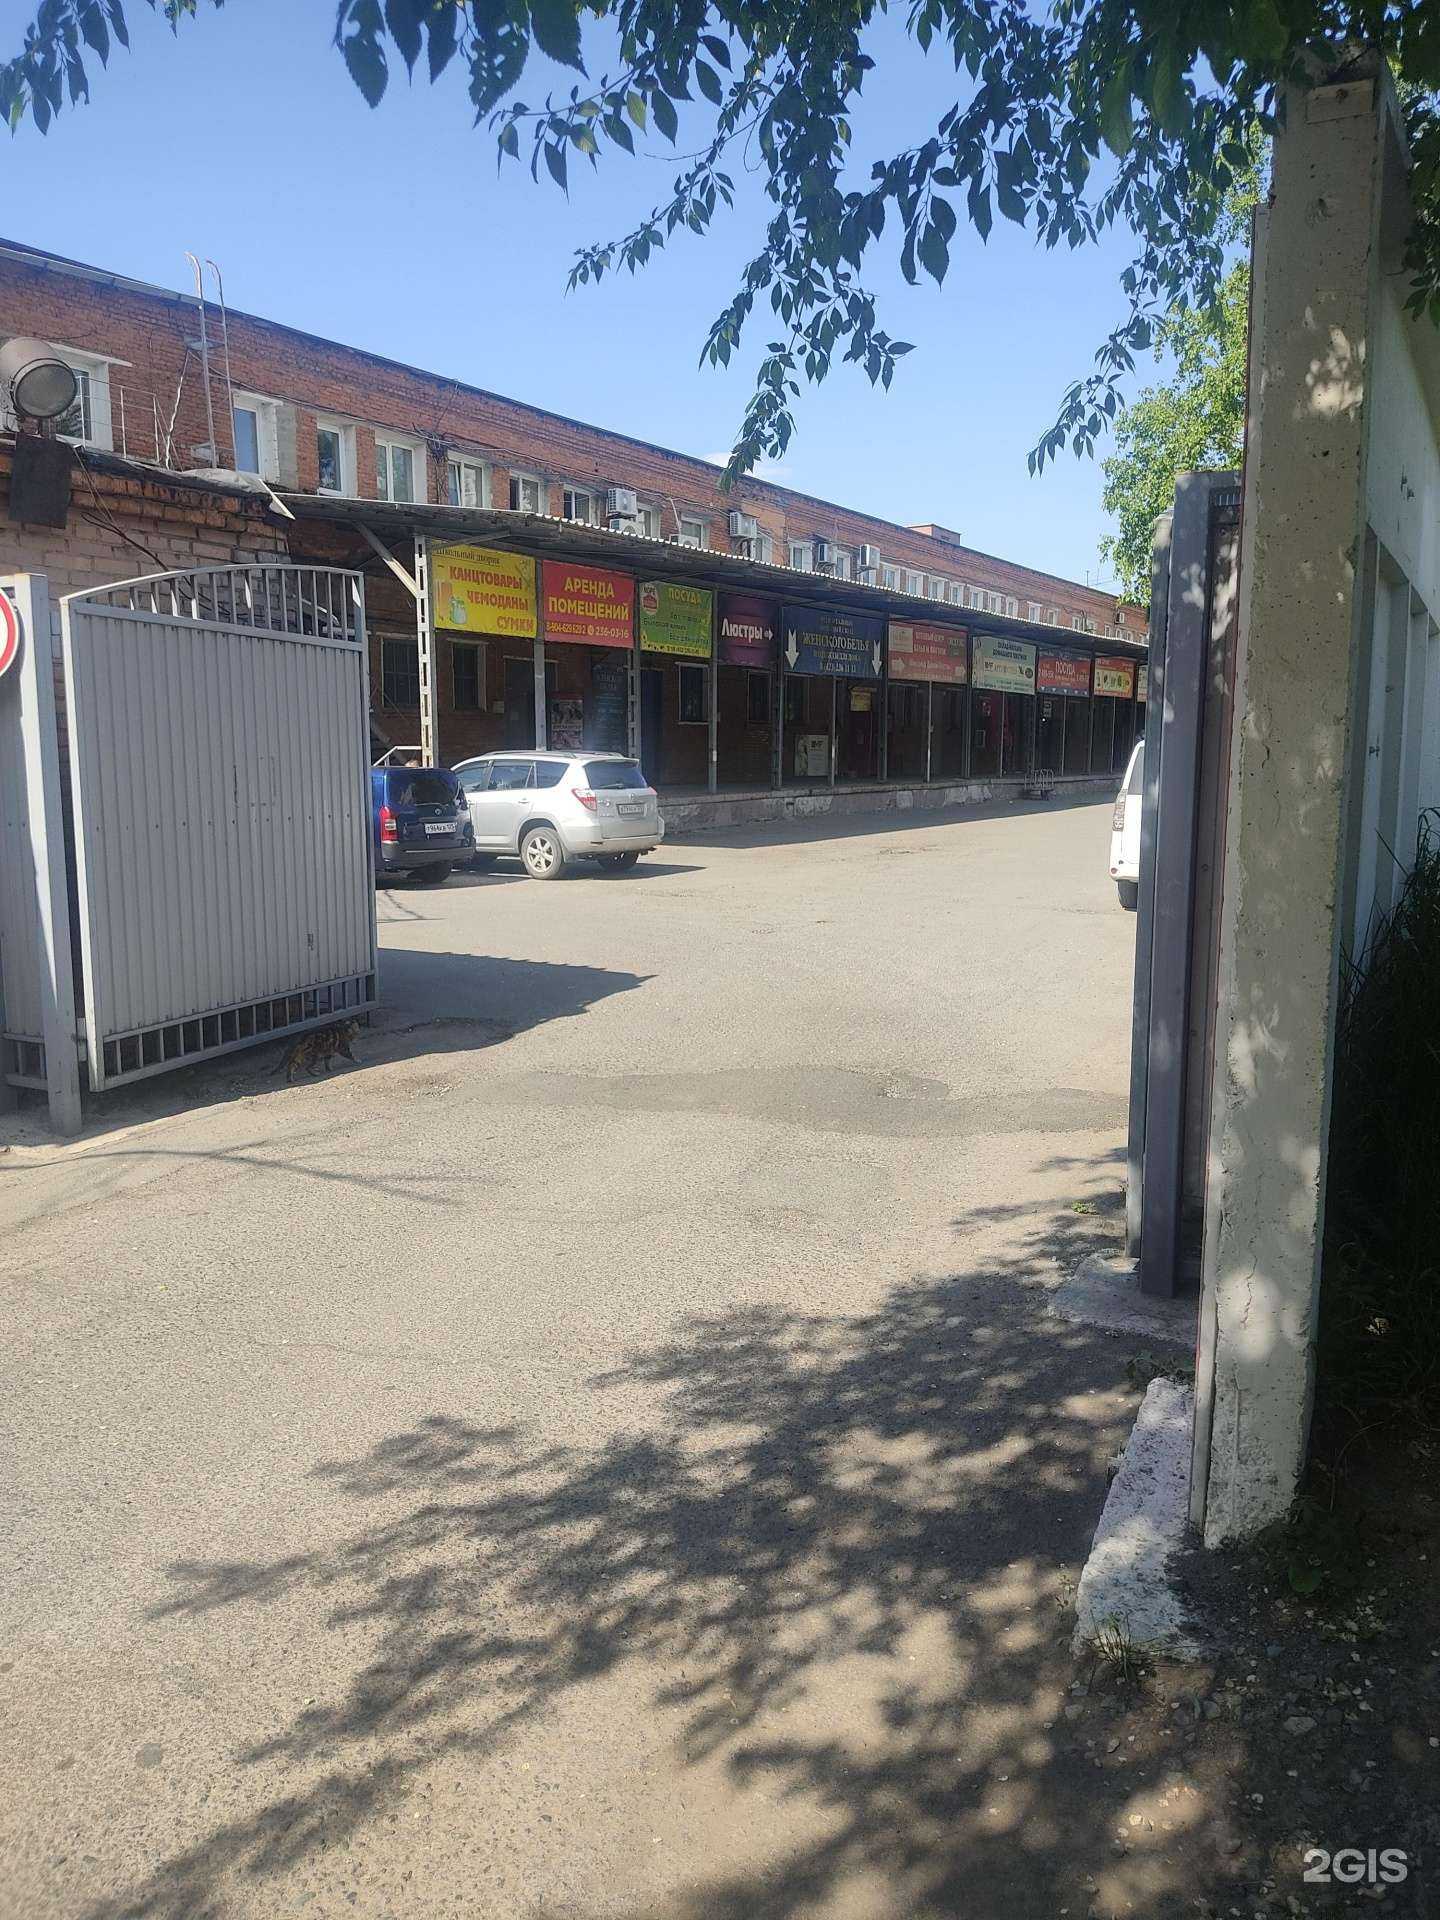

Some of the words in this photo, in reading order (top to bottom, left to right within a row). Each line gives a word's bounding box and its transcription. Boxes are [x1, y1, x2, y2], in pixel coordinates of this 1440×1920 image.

[449, 566, 522, 589] КАНЦТОВАРЫ
[564, 576, 615, 599] АРЕНДА
[467, 590, 529, 611] ЧЕМОДАНЫ
[669, 588, 702, 605] ПОСУДА
[548, 596, 629, 620] ПОМЕЩЕНИЙ
[496, 616, 534, 633] СУМКИ
[721, 618, 763, 643] Люстры
[802, 632, 847, 649] ЖЕНСКОГО
